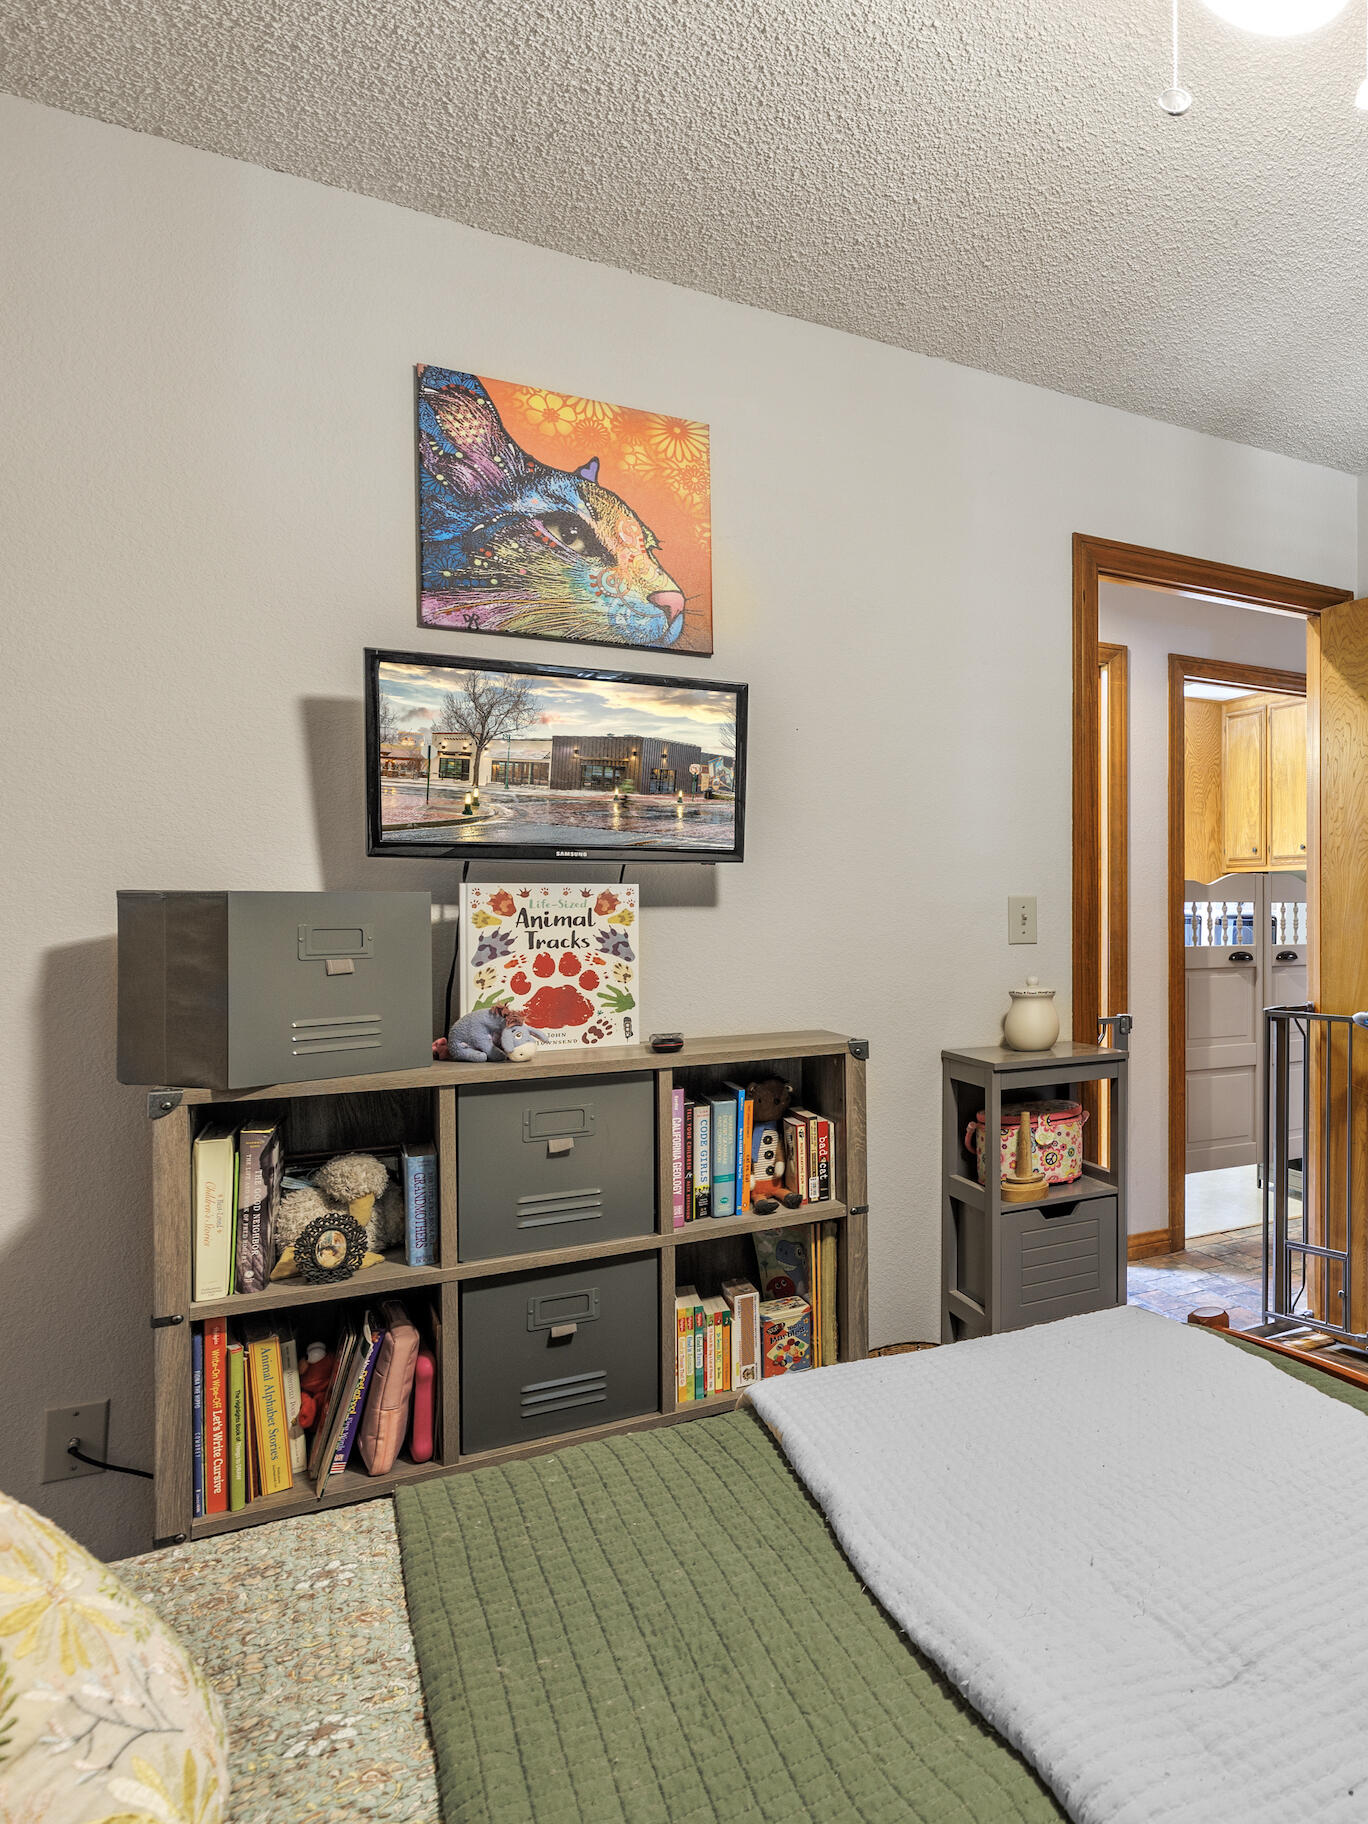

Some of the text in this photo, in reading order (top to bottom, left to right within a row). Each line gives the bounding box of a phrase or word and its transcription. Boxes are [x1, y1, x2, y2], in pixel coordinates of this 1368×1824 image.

[515, 907, 596, 929] Animal
[529, 898, 588, 909] Life-Sized
[524, 930, 590, 950] Tracks
[672, 1118, 681, 1160] CALIFORNIA
[700, 1120, 708, 1146] CODE
[819, 1136, 827, 1156] bad
[673, 1162, 682, 1195] GEOLOGY
[700, 1151, 708, 1182] GIRLS
[203, 1182, 217, 1218] Children's
[251, 1170, 262, 1255] THE GOOD NEIGHBOR
[414, 1173, 427, 1248] GRANDMOTHERS
[260, 1348, 274, 1381] Animal
[210, 1349, 225, 1494] Write-On Wipe-Off Let's Write Cursive
[262, 1385, 278, 1426] Alphabet
[268, 1430, 280, 1460] Stories
